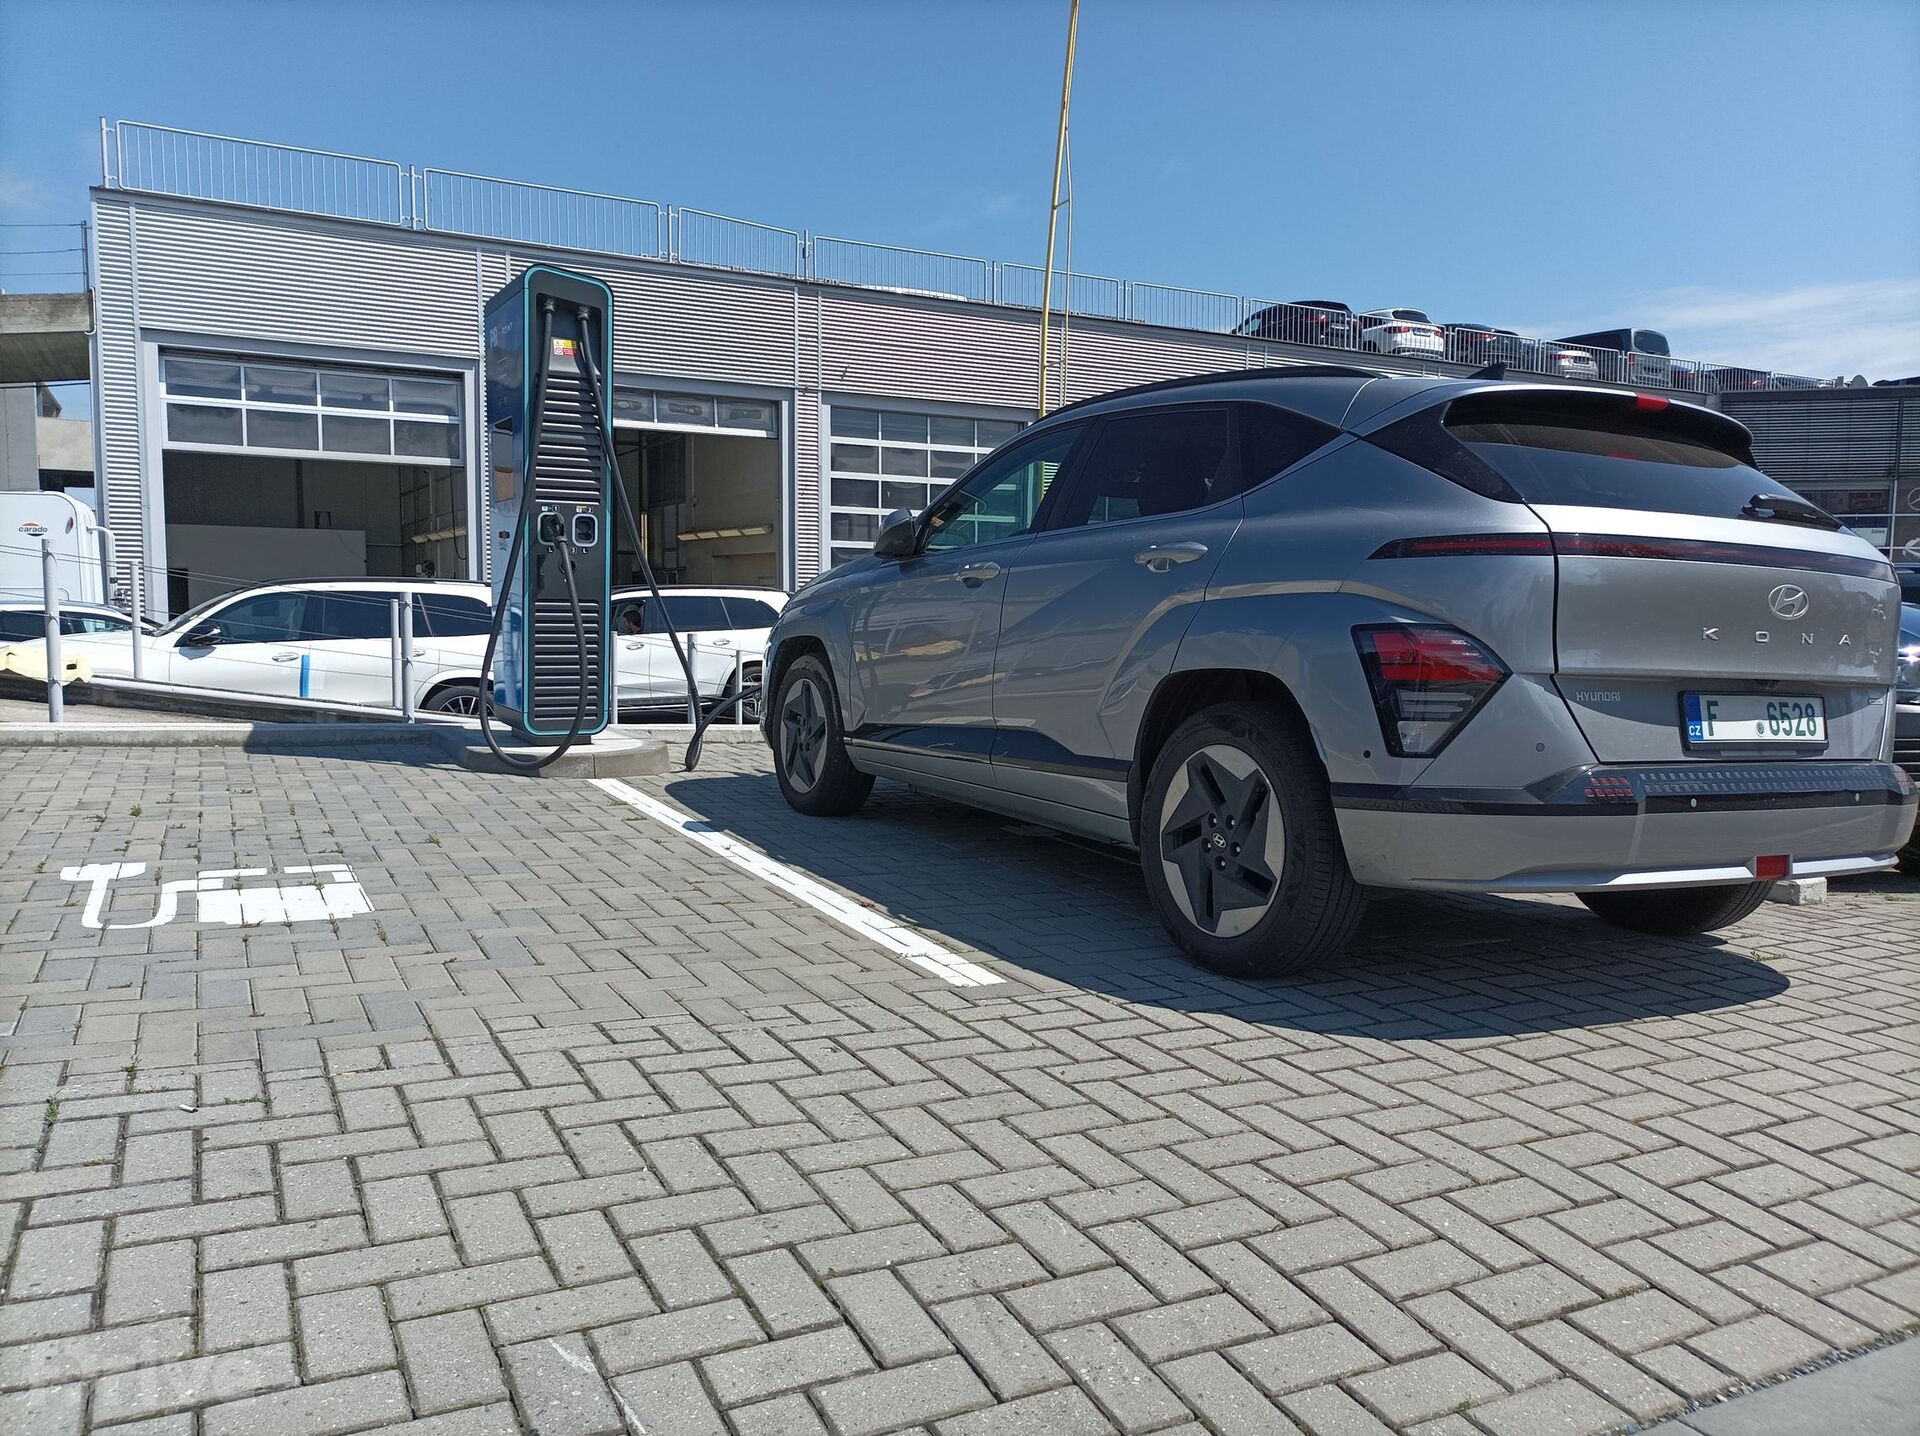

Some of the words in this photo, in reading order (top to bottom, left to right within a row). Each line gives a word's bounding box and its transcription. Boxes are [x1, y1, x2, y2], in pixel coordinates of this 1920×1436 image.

[1702, 627, 1852, 646] KONA
[1576, 691, 1621, 702] HYUNDAI
[1706, 700, 1719, 737] F
[1766, 701, 1817, 737] 6528
[1688, 725, 1701, 736] CZ
